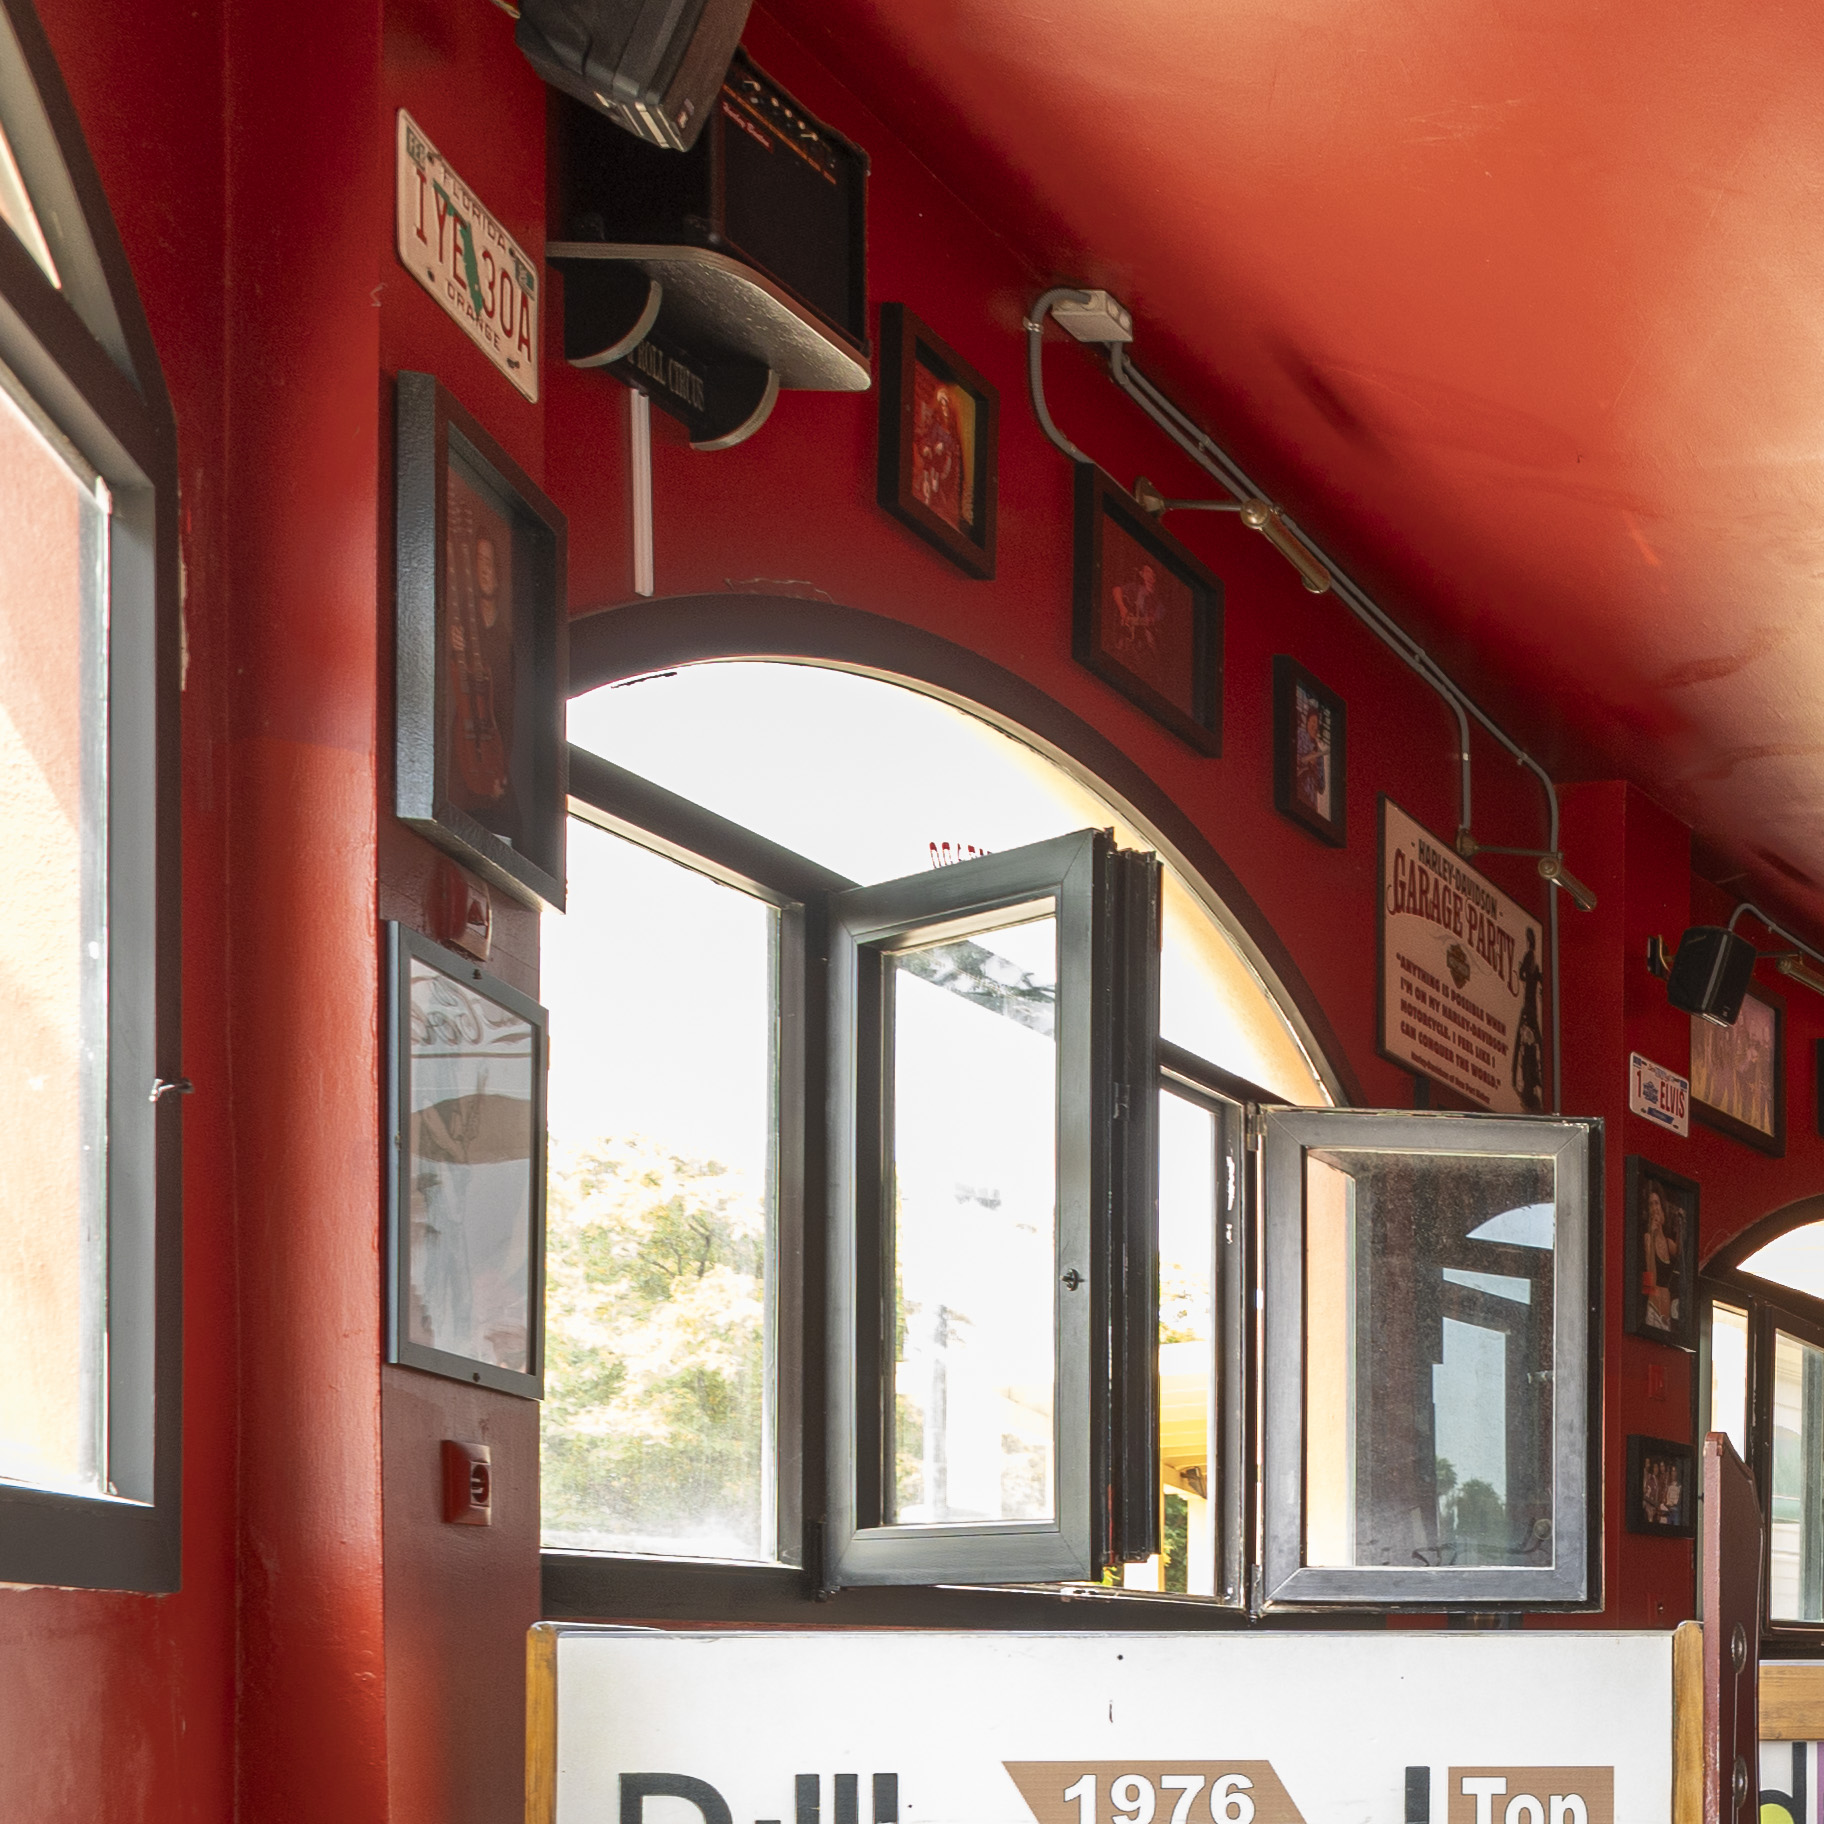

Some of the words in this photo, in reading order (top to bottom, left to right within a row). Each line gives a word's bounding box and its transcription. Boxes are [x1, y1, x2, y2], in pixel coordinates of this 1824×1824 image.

[415, 167, 467, 291] IYE
[441, 166, 506, 253] FLORIDA
[447, 279, 500, 352] ORANGE
[1418, 838, 1497, 920] HARLEY-DAVIDSON
[1387, 848, 1463, 939] GARAGE
[1465, 897, 1519, 998] PARTY
[1659, 1080, 1685, 1119] ELVIS
